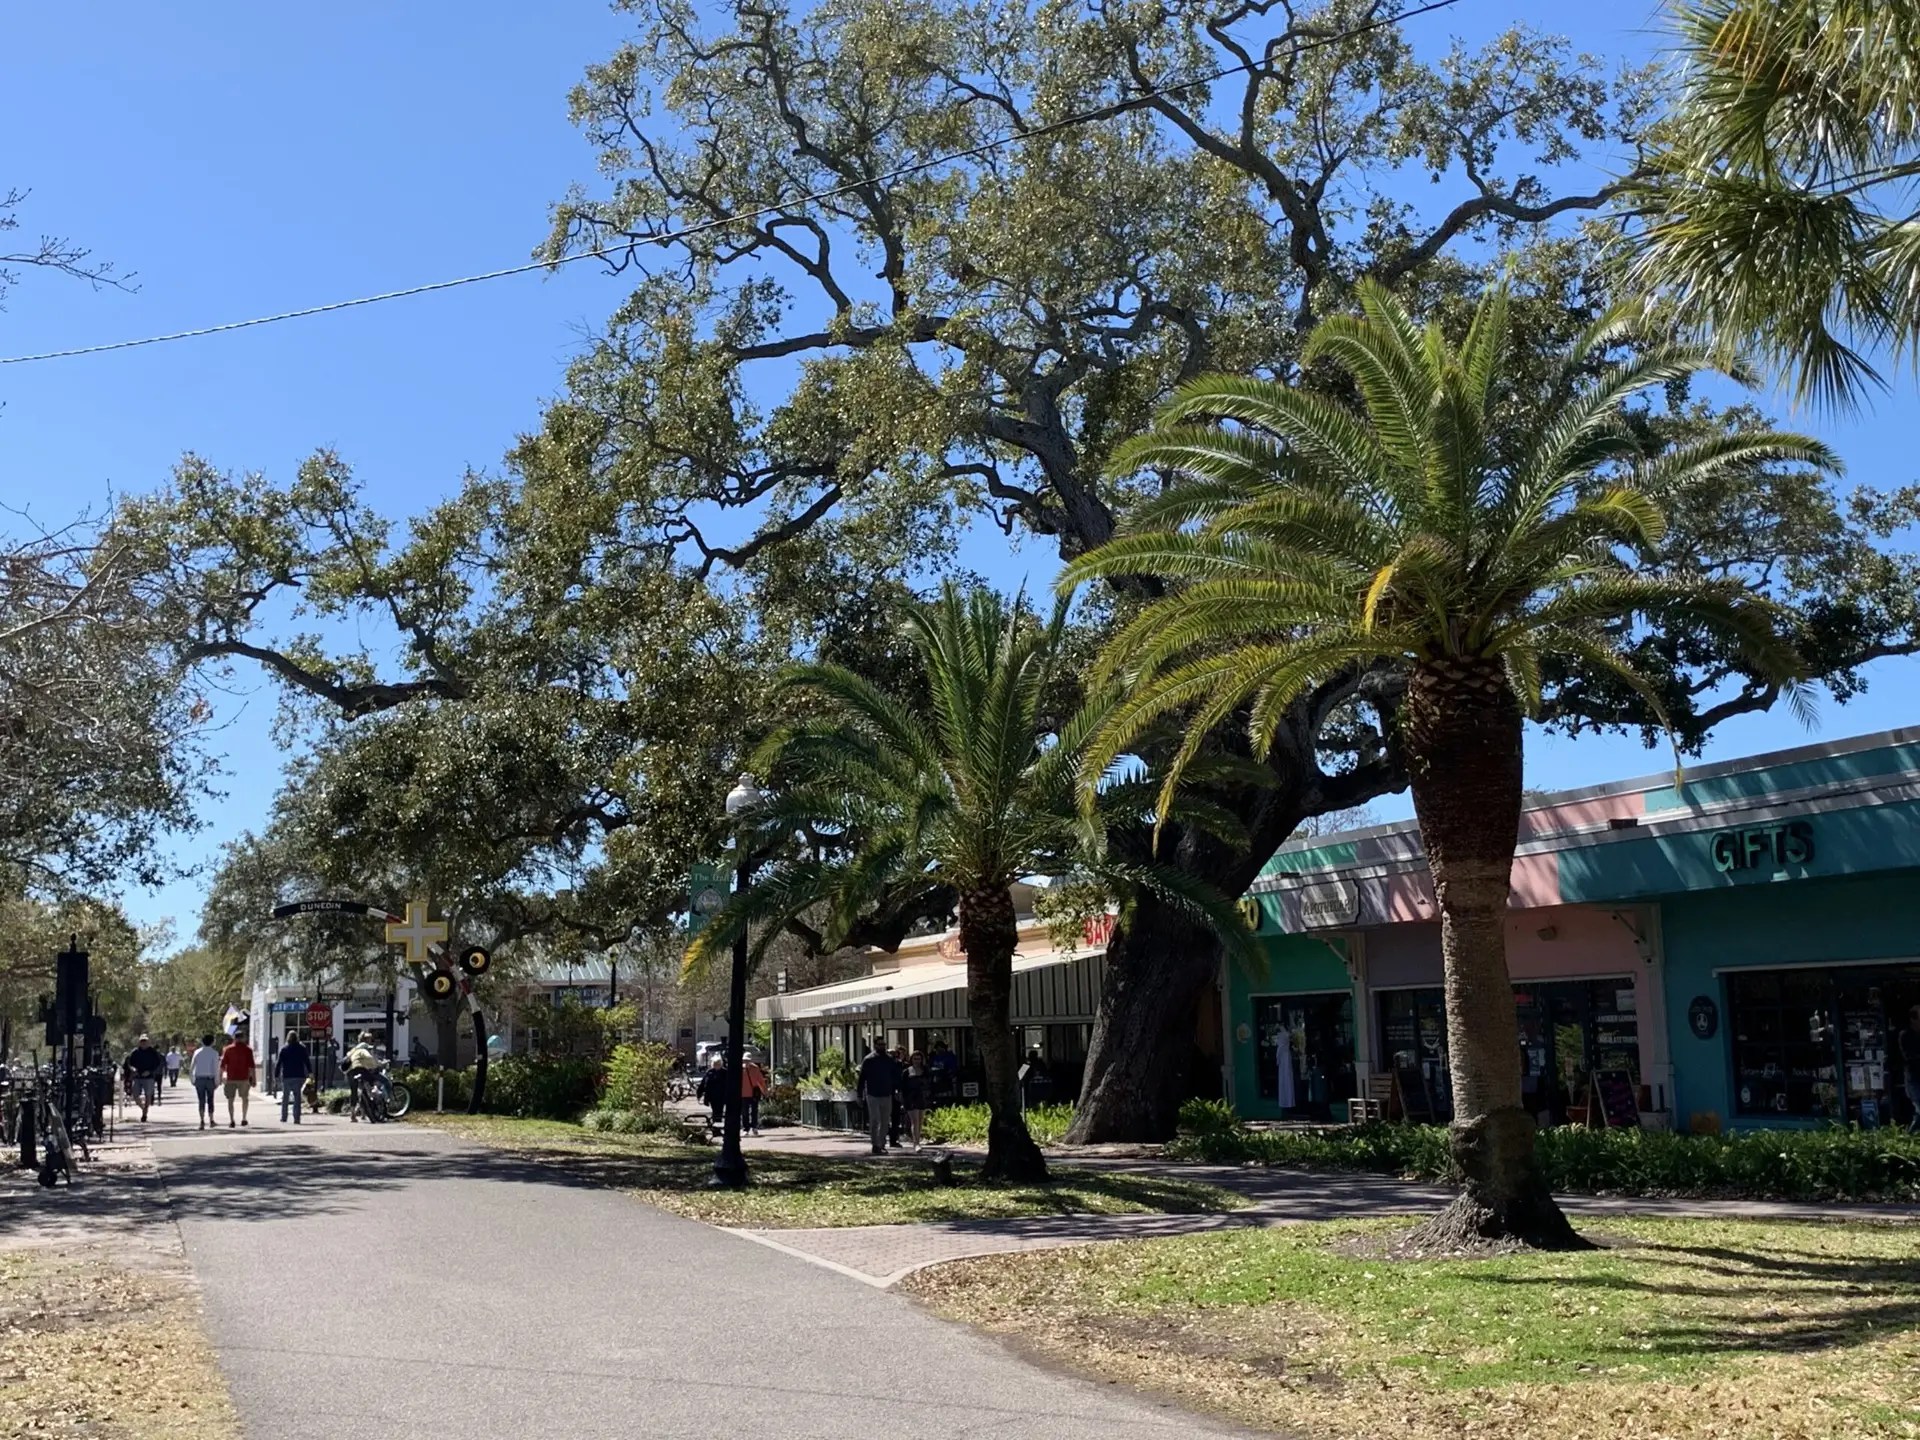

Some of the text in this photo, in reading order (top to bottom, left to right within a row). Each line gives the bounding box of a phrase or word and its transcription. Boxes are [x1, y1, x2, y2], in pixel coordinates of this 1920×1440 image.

[1711, 822, 1812, 872] GIFTS
[300, 902, 342, 911] DUNEDIN
[307, 1011, 331, 1021] STOP
